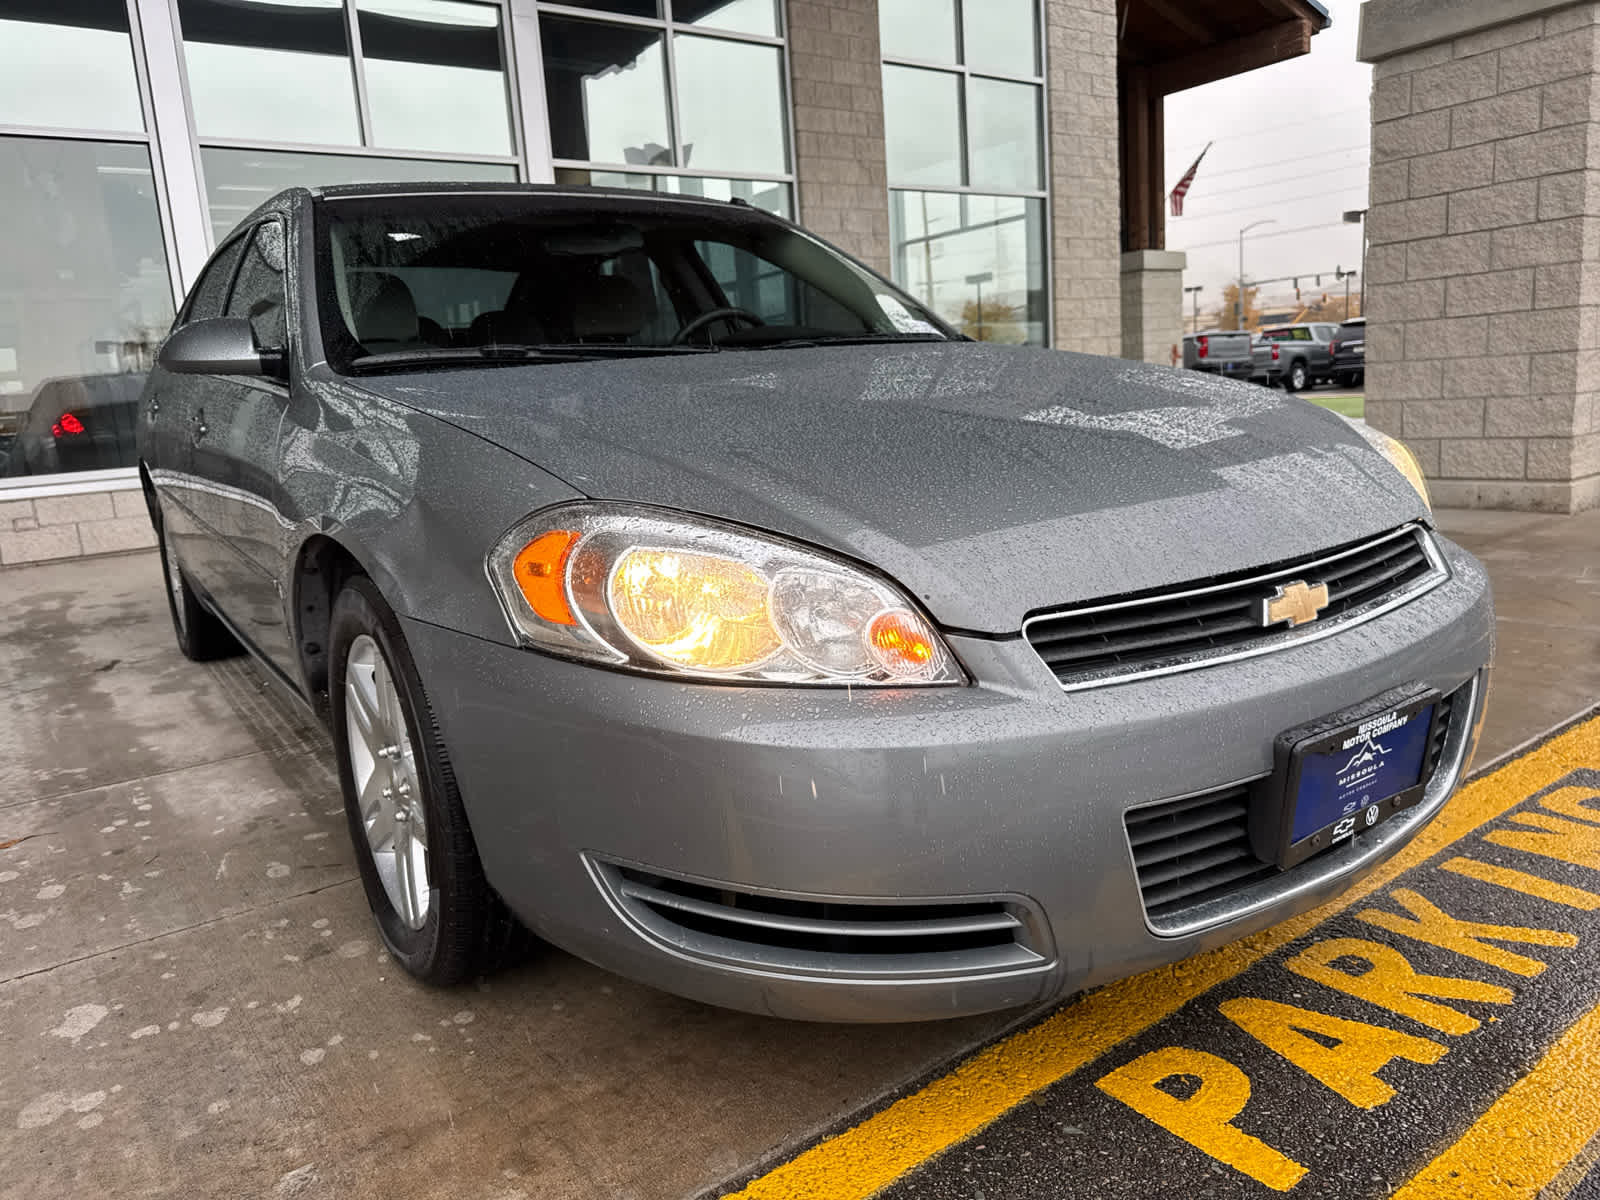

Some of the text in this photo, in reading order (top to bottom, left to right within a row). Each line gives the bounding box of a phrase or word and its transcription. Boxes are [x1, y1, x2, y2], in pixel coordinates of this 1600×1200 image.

[1343, 715, 1408, 750] MOTOR COMPANY
[1358, 711, 1397, 735] MISSOULA
[1338, 761, 1384, 785] MISSOULA
